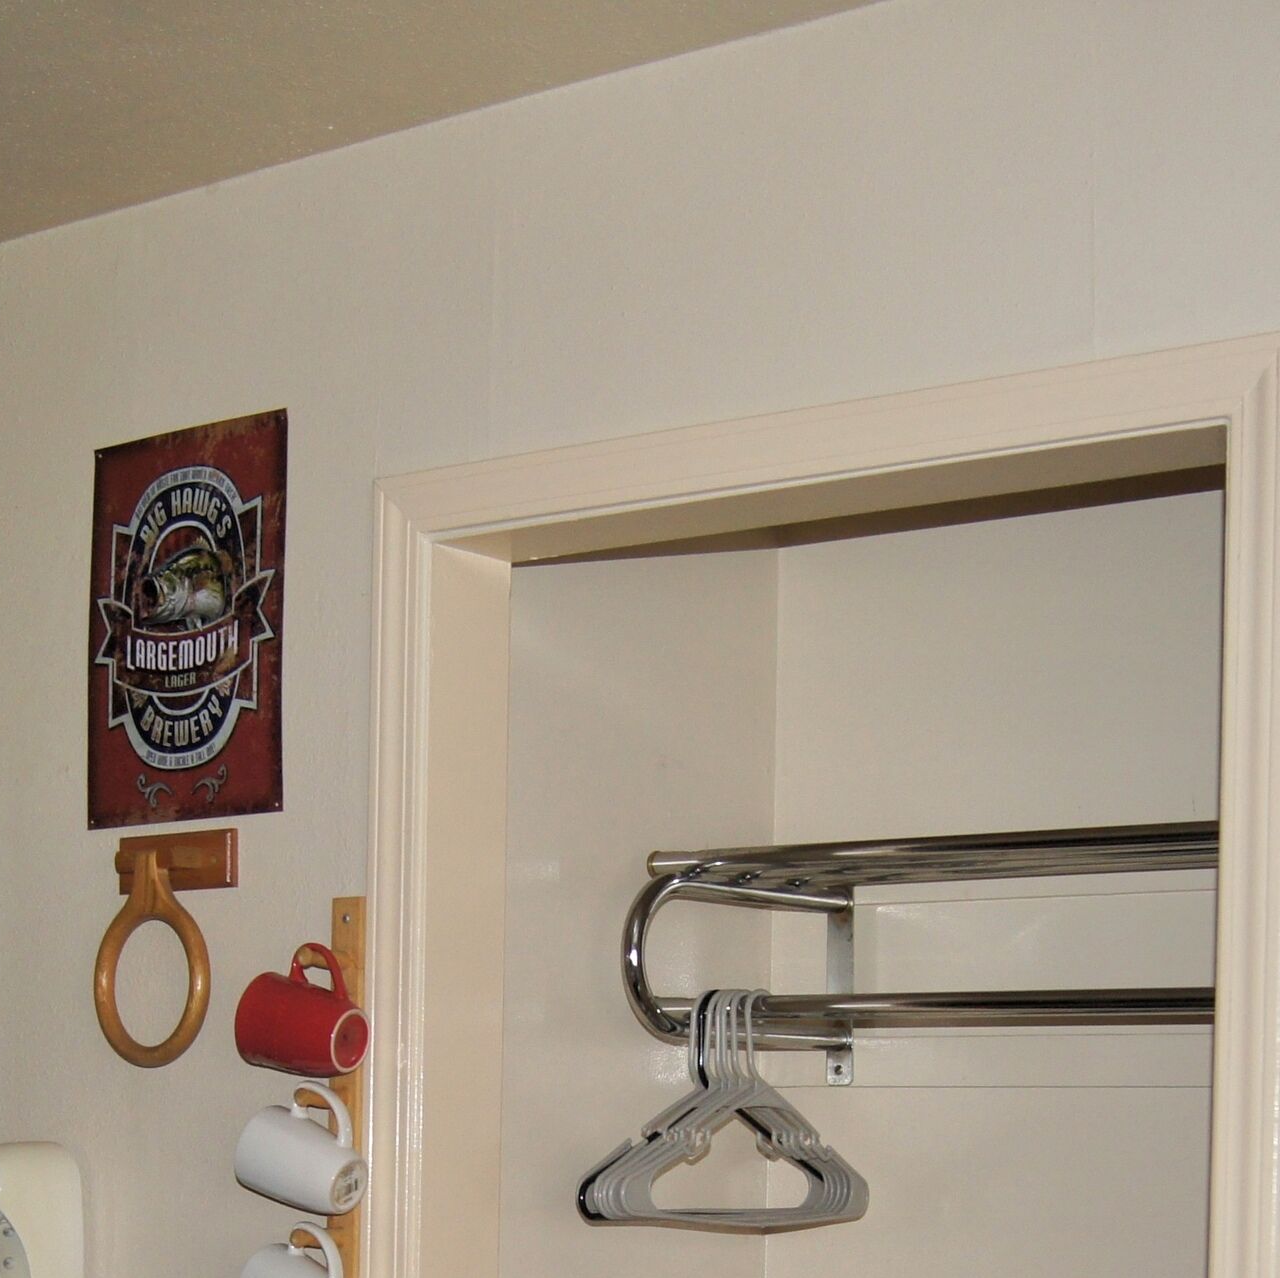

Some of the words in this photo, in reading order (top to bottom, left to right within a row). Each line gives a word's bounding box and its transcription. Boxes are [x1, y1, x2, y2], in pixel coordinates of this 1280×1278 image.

[139, 501, 168, 544] BIG
[171, 487, 232, 538] HAWG'S
[126, 620, 239, 671] LARGEMOUTH
[165, 672, 197, 688] LAGER
[140, 694, 224, 748] BREWERY
